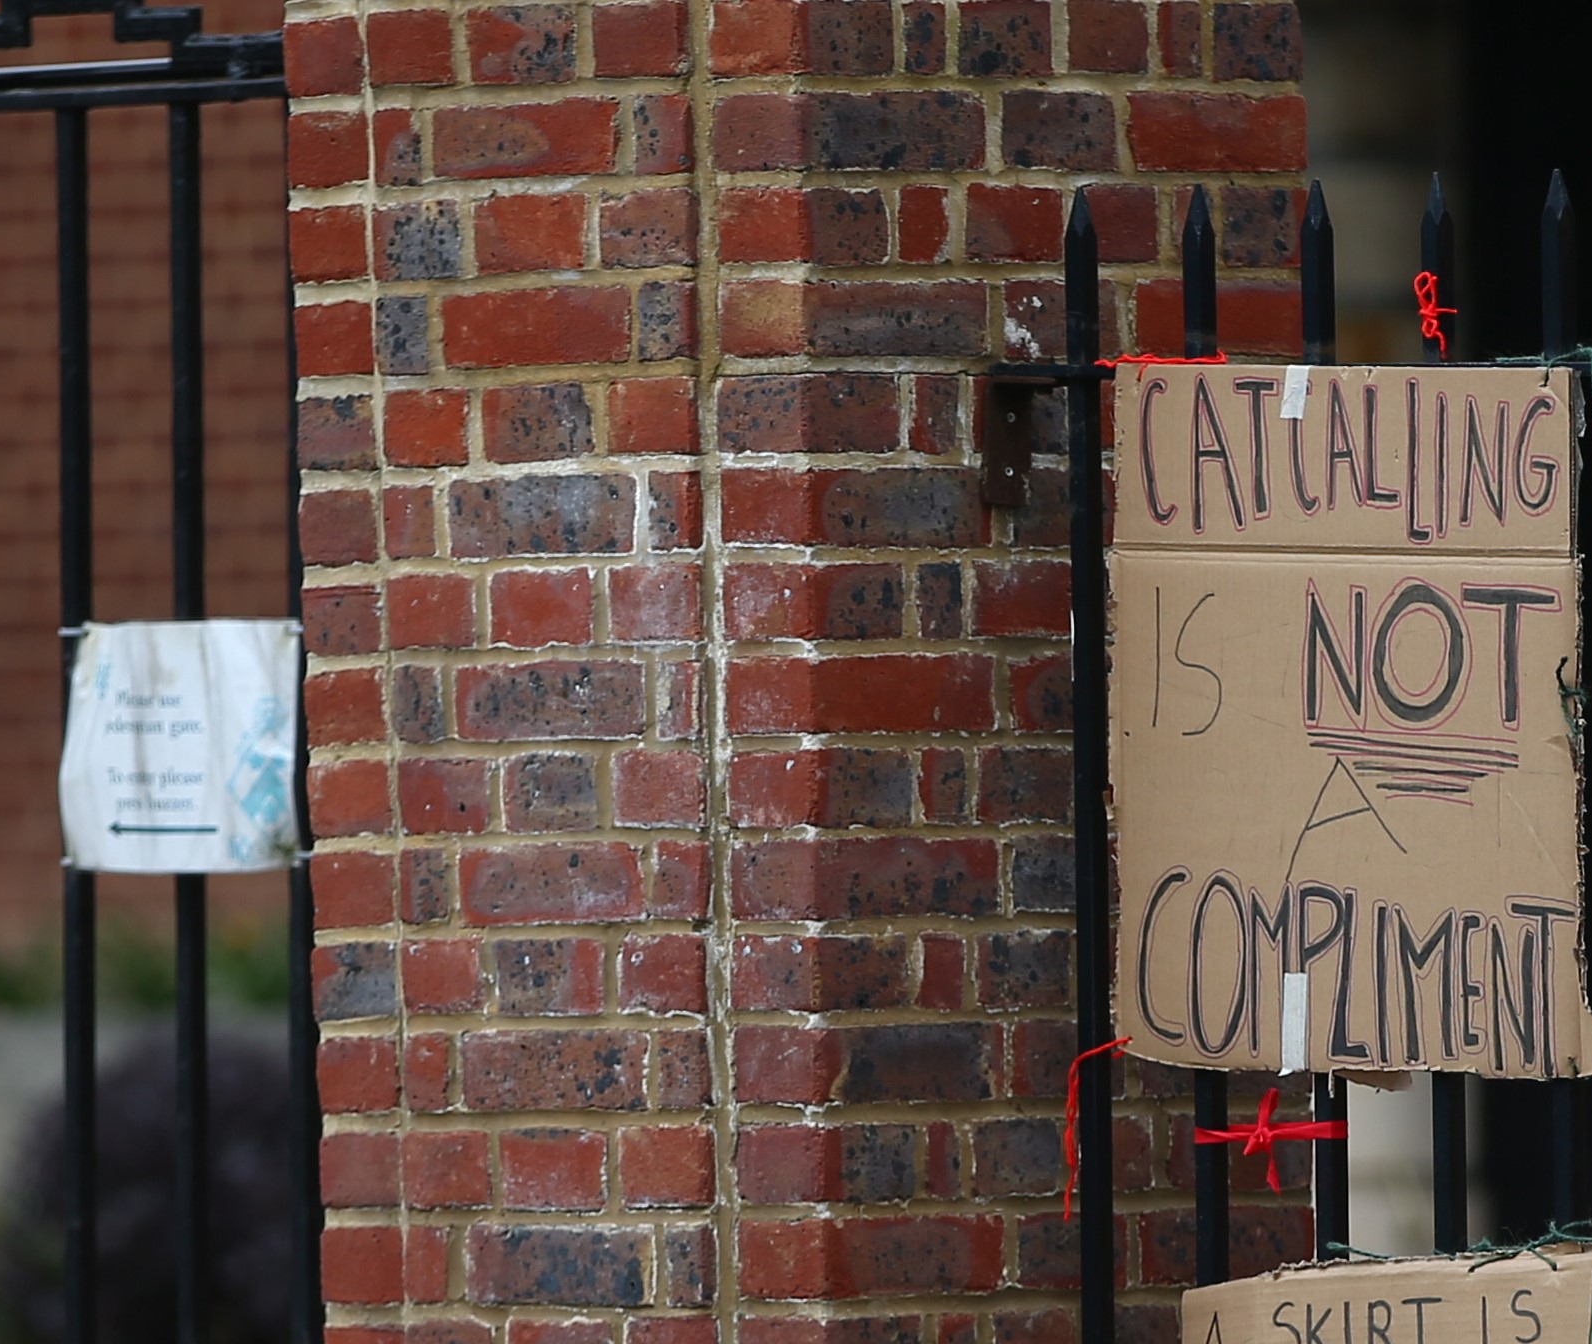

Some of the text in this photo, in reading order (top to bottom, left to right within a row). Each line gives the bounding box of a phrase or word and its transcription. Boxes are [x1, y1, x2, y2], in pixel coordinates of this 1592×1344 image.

[1139, 374, 1561, 543] CATCALLING
[1152, 577, 1563, 736] IS NOT
[1286, 757, 1408, 882] A
[1137, 866, 1577, 1075] COMPLIMENT
